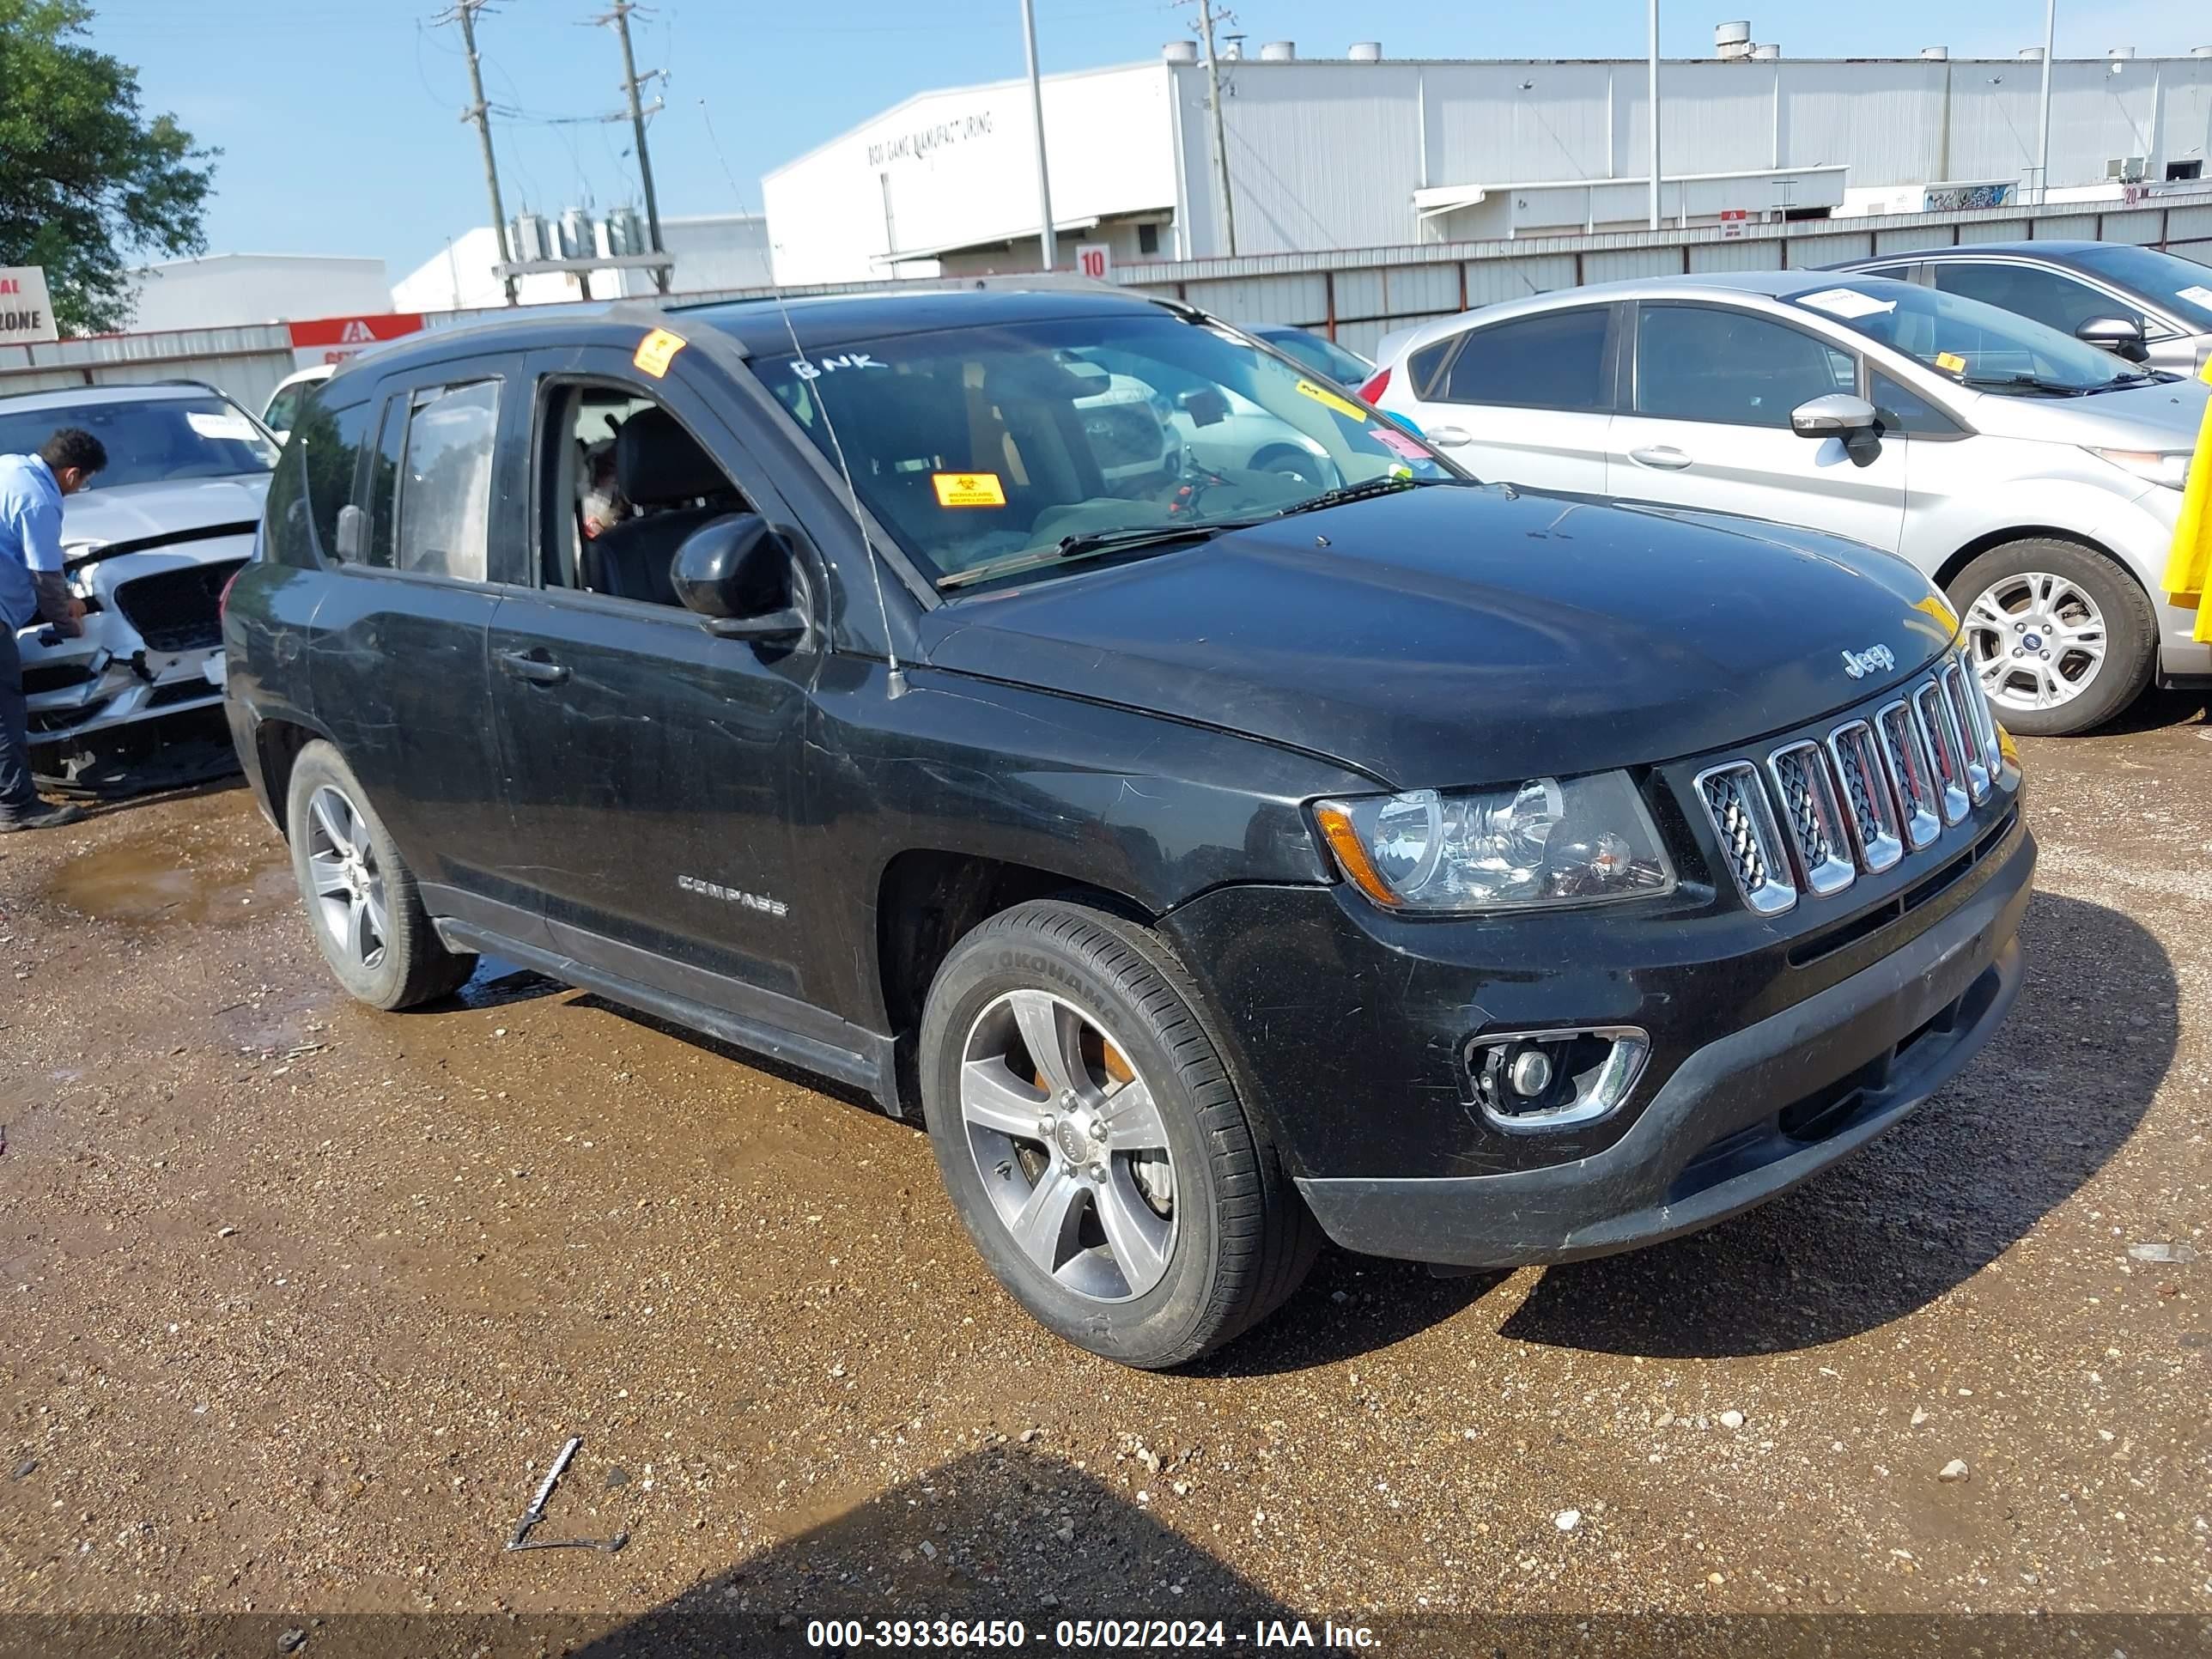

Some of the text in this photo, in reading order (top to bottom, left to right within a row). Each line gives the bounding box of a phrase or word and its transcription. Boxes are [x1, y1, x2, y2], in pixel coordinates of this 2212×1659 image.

[2125, 187, 2136, 204] 20
[1082, 251, 1103, 276] 10
[1841, 644, 1895, 678] Jeep
[678, 874, 788, 917] COMPASS
[986, 950, 1120, 1028] YOKOHAMA
